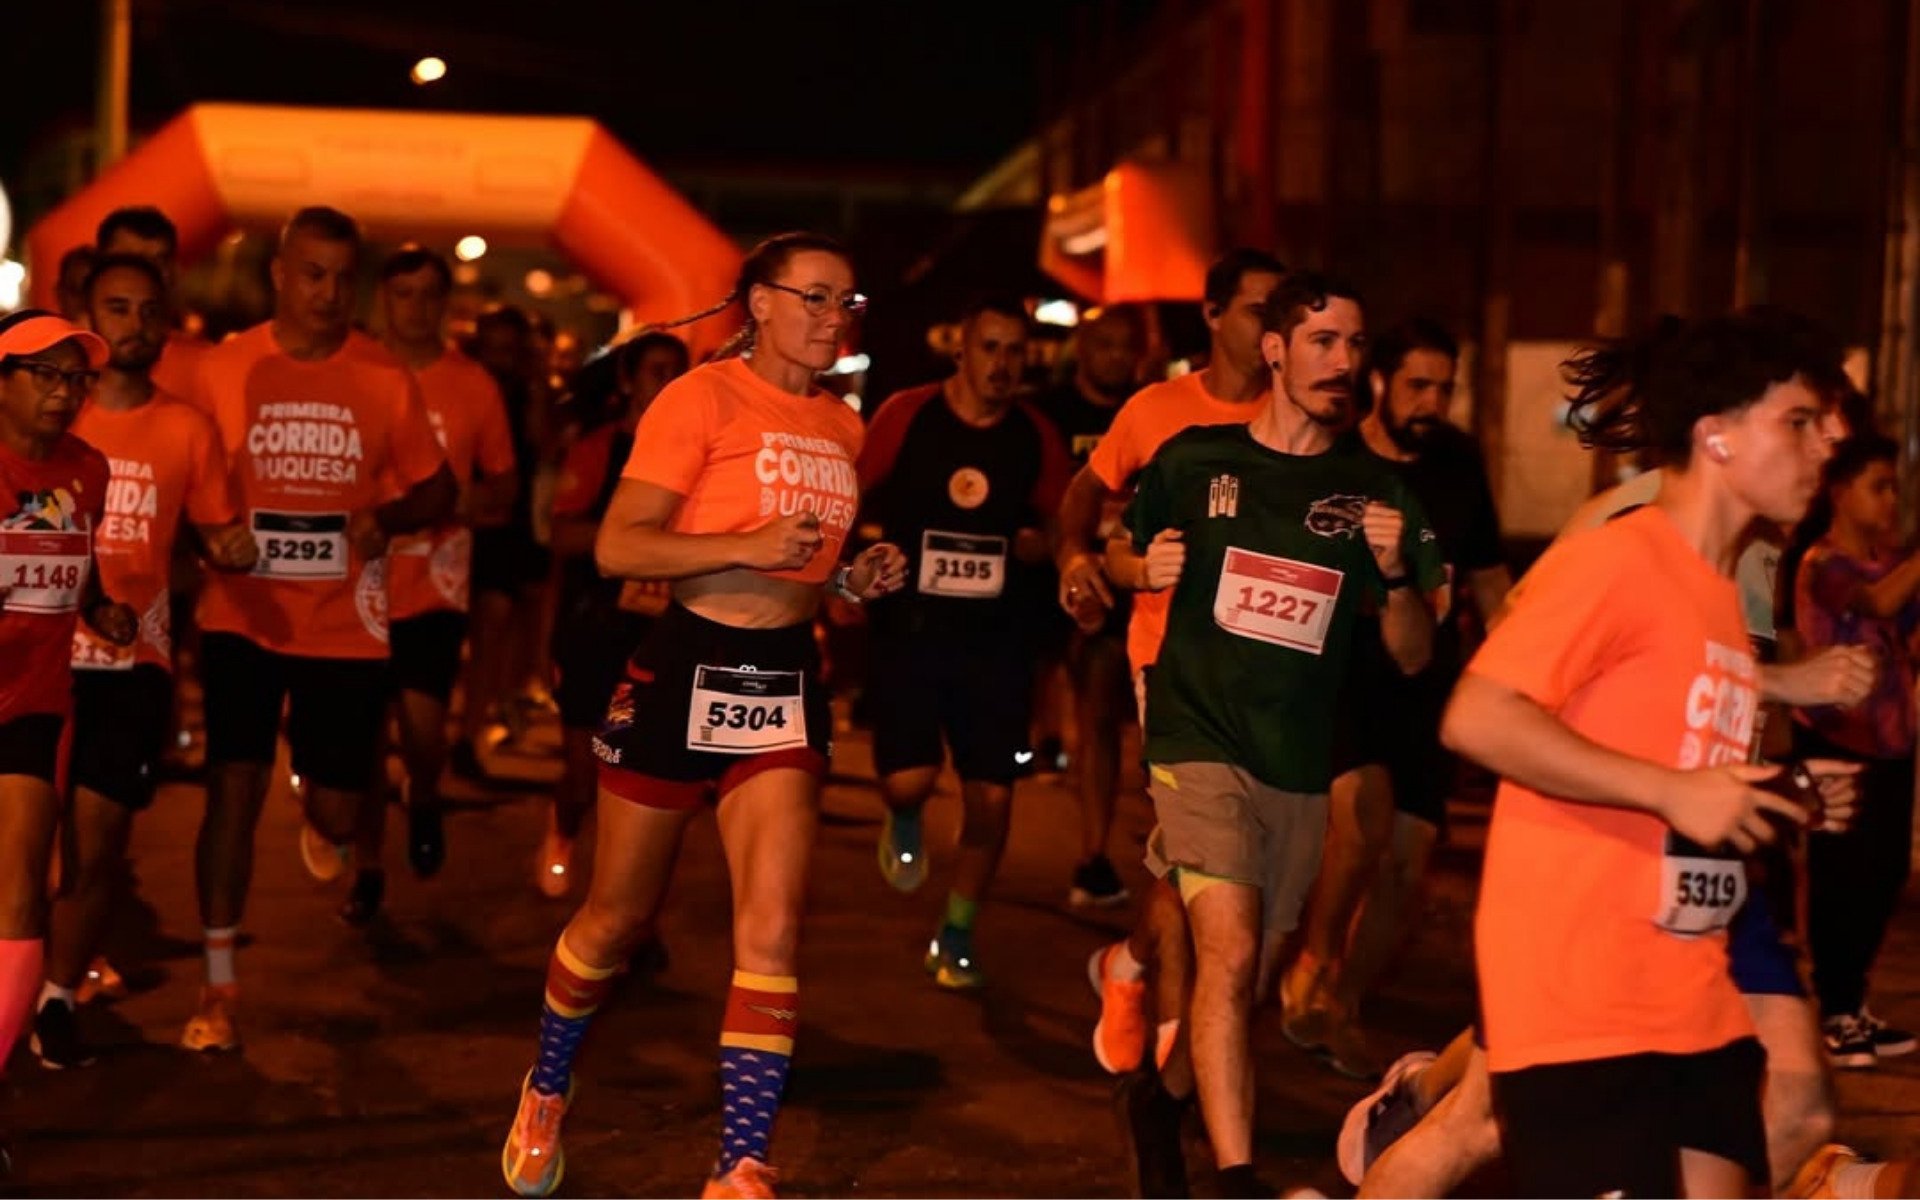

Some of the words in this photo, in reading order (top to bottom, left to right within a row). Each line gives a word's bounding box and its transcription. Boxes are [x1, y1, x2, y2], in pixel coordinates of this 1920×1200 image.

[259, 402, 354, 423] PRIMEIRA
[248, 422, 363, 459] CORRIDA
[755, 447, 858, 500] CORRID
[266, 538, 333, 560] 5292
[12, 564, 79, 590] 1148
[935, 558, 991, 580] 3195
[1236, 585, 1318, 626] 1227
[707, 702, 786, 731] 5304
[1677, 871, 1736, 908] 5319
